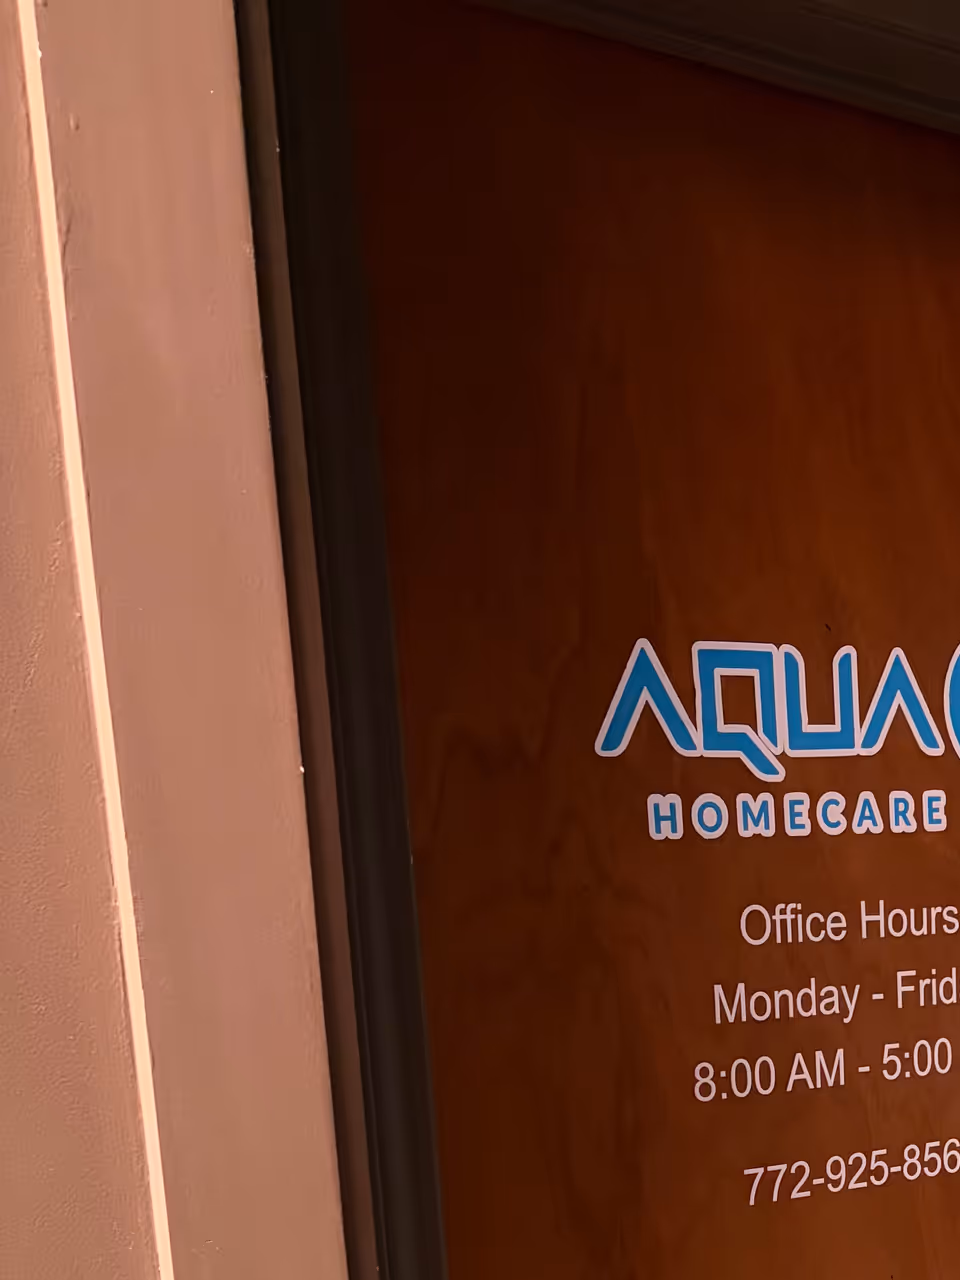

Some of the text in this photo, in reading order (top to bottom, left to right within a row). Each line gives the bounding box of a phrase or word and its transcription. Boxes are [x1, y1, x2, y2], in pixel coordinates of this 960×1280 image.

[594, 638, 945, 782] AQUA
[647, 789, 947, 840] HOMECARE
[739, 902, 847, 946] Office
[713, 977, 860, 1024] Monday
[693, 1055, 776, 1102] 8:00
[786, 1048, 845, 1092] AM
[882, 1037, 952, 1081] 5:00
